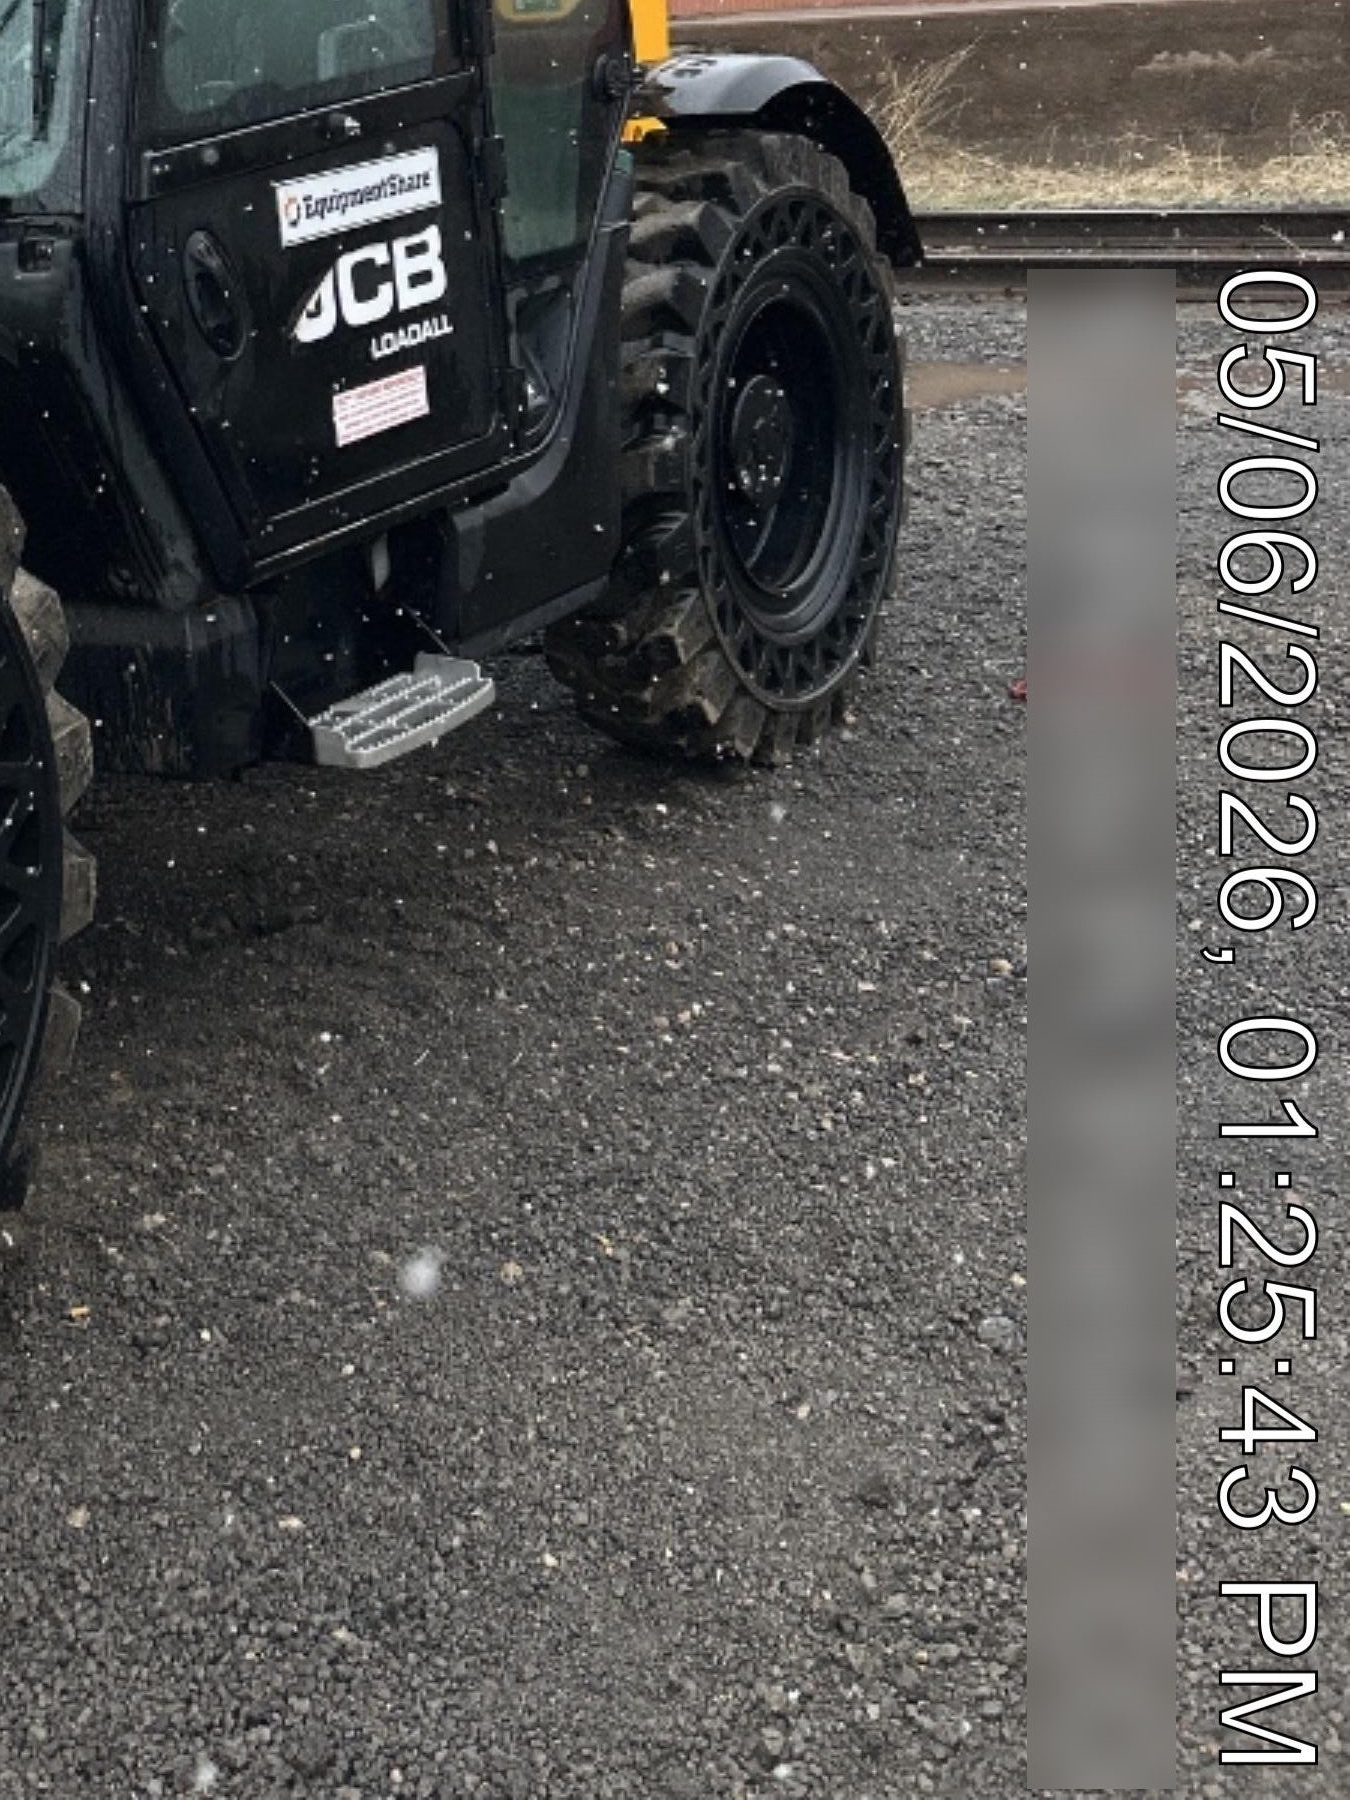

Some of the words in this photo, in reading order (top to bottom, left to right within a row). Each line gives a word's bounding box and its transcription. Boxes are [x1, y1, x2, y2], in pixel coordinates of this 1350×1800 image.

[302, 170, 430, 219] EquipmentShare
[292, 223, 448, 343] JCB
[371, 314, 454, 360] LOADALL
